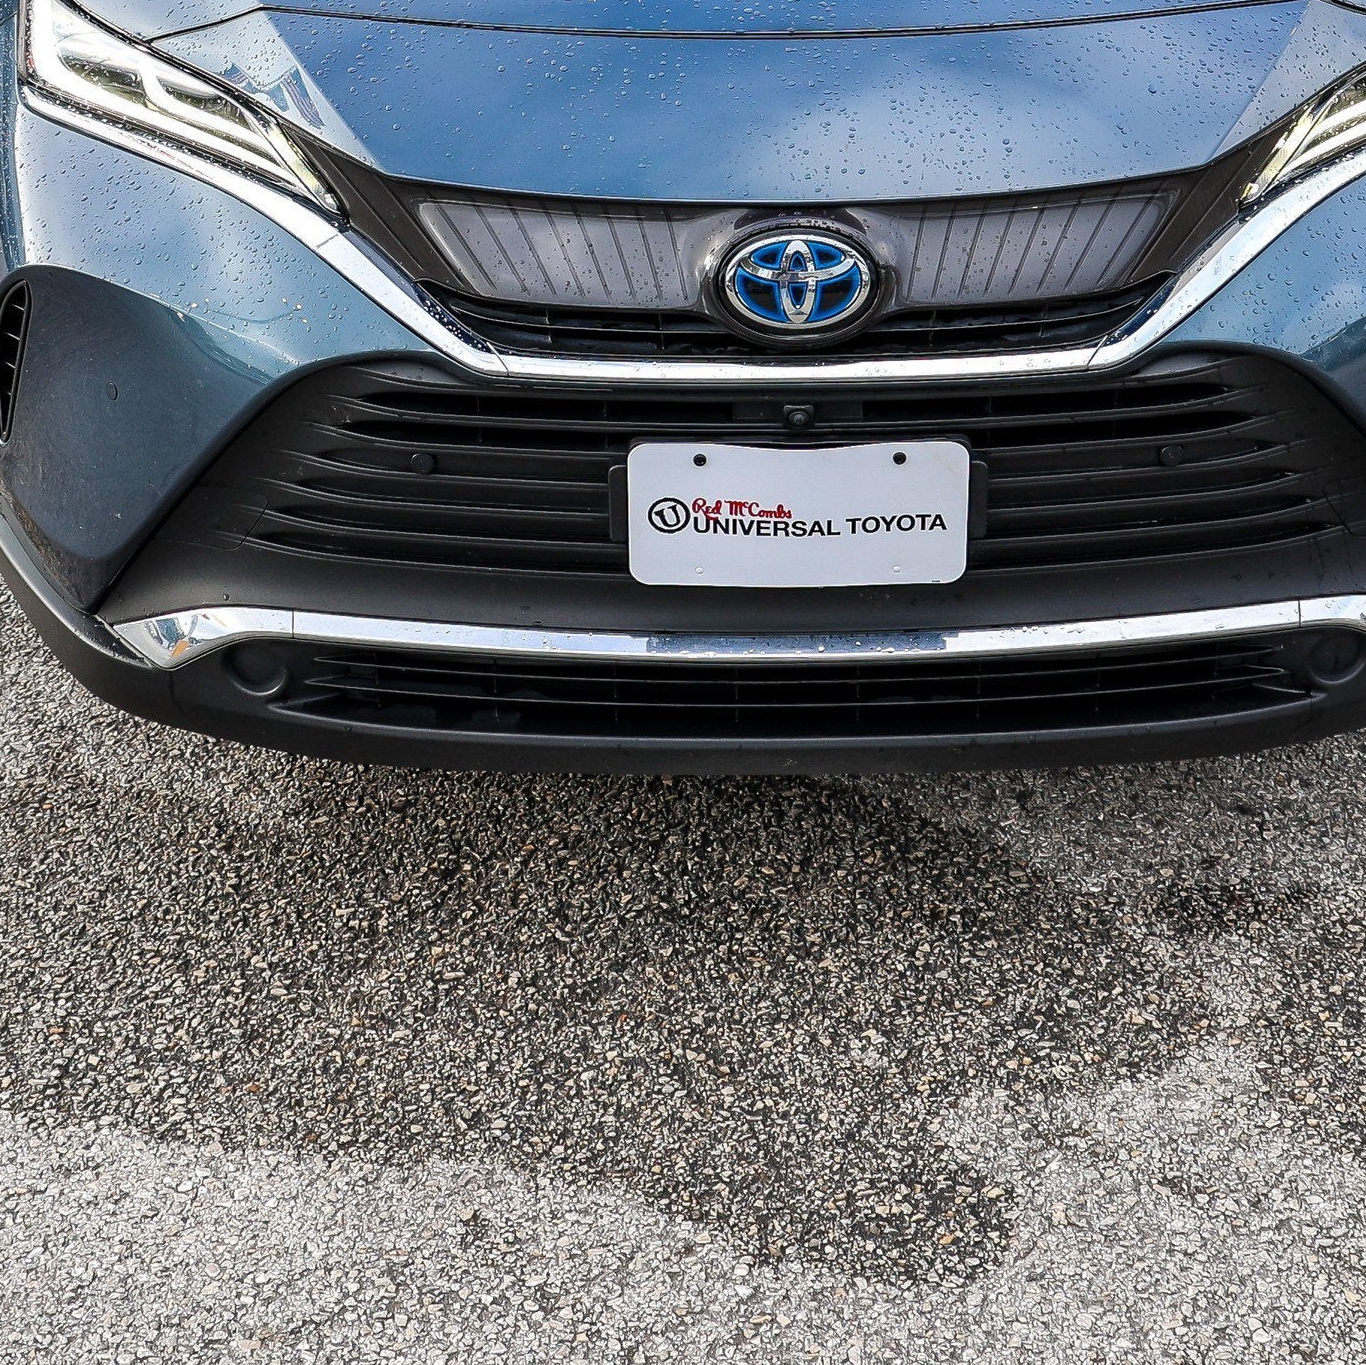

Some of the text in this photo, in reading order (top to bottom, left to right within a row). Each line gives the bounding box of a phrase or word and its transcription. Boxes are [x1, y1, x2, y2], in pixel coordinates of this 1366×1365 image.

[692, 498, 792, 520] Red McCombs
[693, 514, 948, 537] UNIVERSAL TOYOTA
